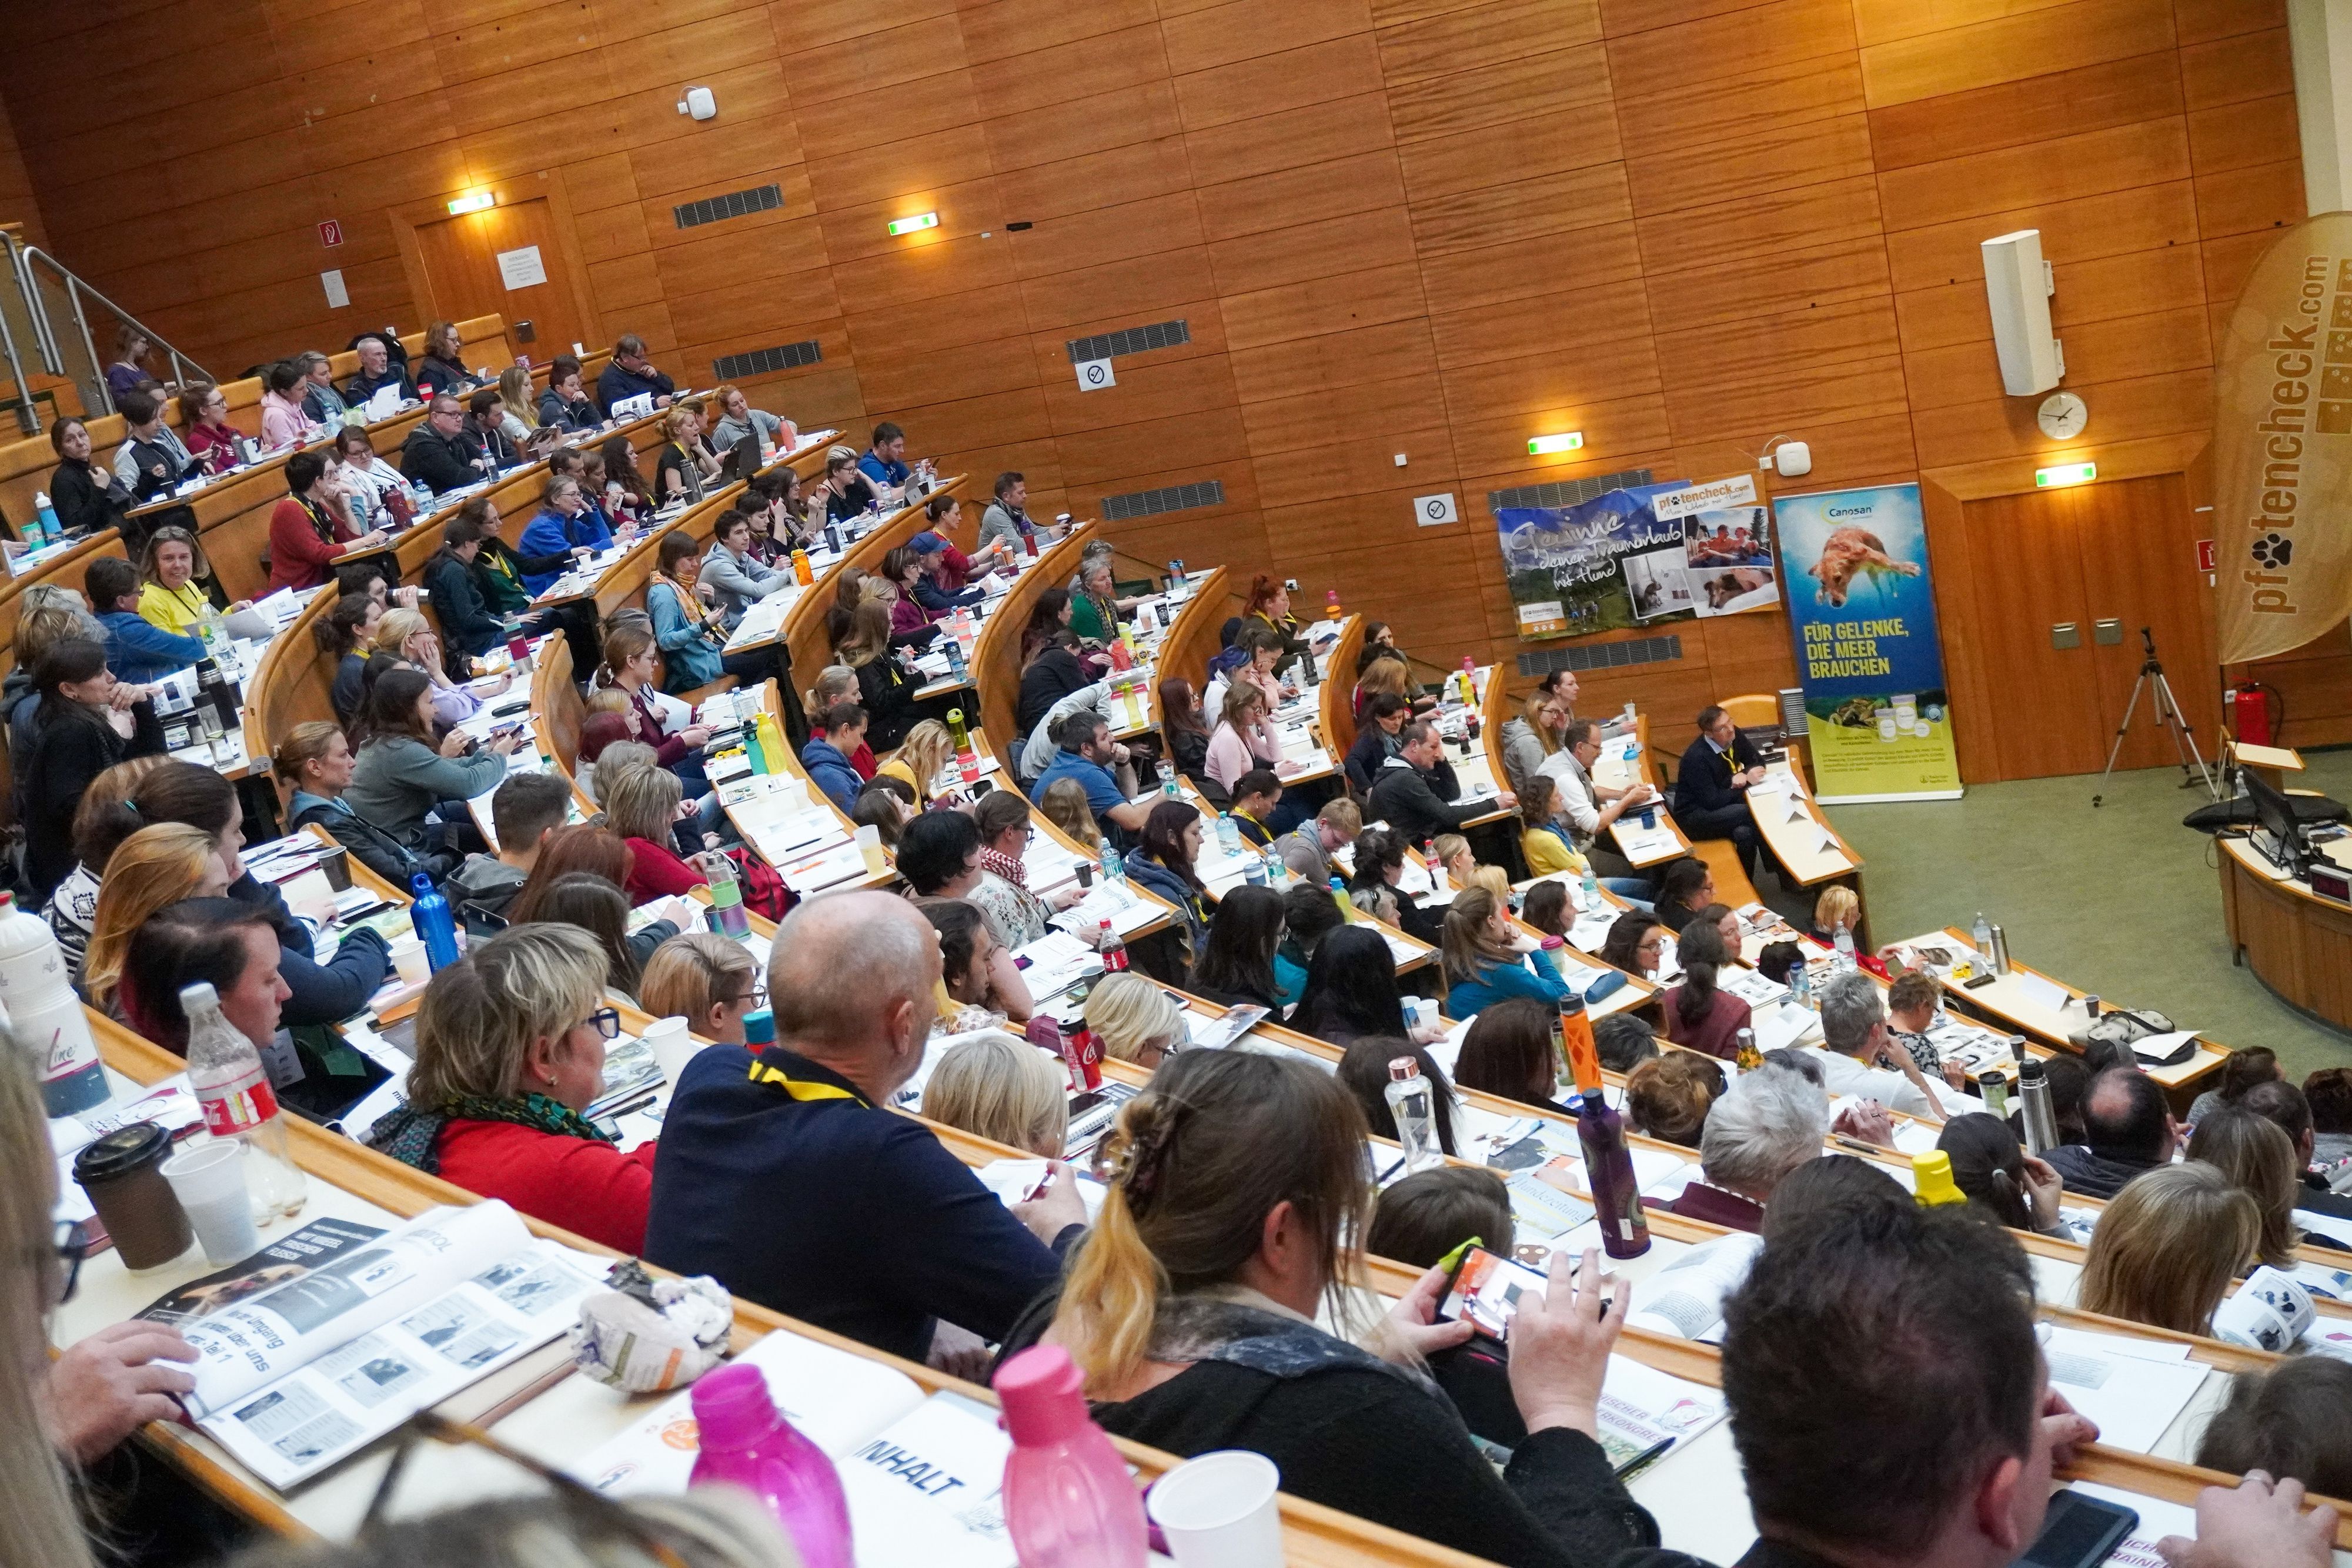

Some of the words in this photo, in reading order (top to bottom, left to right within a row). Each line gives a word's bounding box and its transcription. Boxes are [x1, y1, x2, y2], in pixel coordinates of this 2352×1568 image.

[1829, 506, 1872, 518] Canosan
[1511, 514, 1625, 560] Gewinne
[1590, 523, 1682, 560] Traumurlaub
[1553, 567, 1575, 590] mit
[1577, 558, 1616, 586] Hund
[1803, 620, 1832, 642] FÜR
[1836, 618, 1909, 641] GELENKE,
[1806, 642, 1832, 660] DIE
[1835, 640, 1877, 658] MEER
[1809, 657, 1890, 679] BRAUCHEN
[1506, 1178, 1586, 1223] Hundezeitung
[249, 1313, 285, 1350] Umgang
[246, 1349, 270, 1372] uns
[854, 1439, 966, 1496] INHALT
